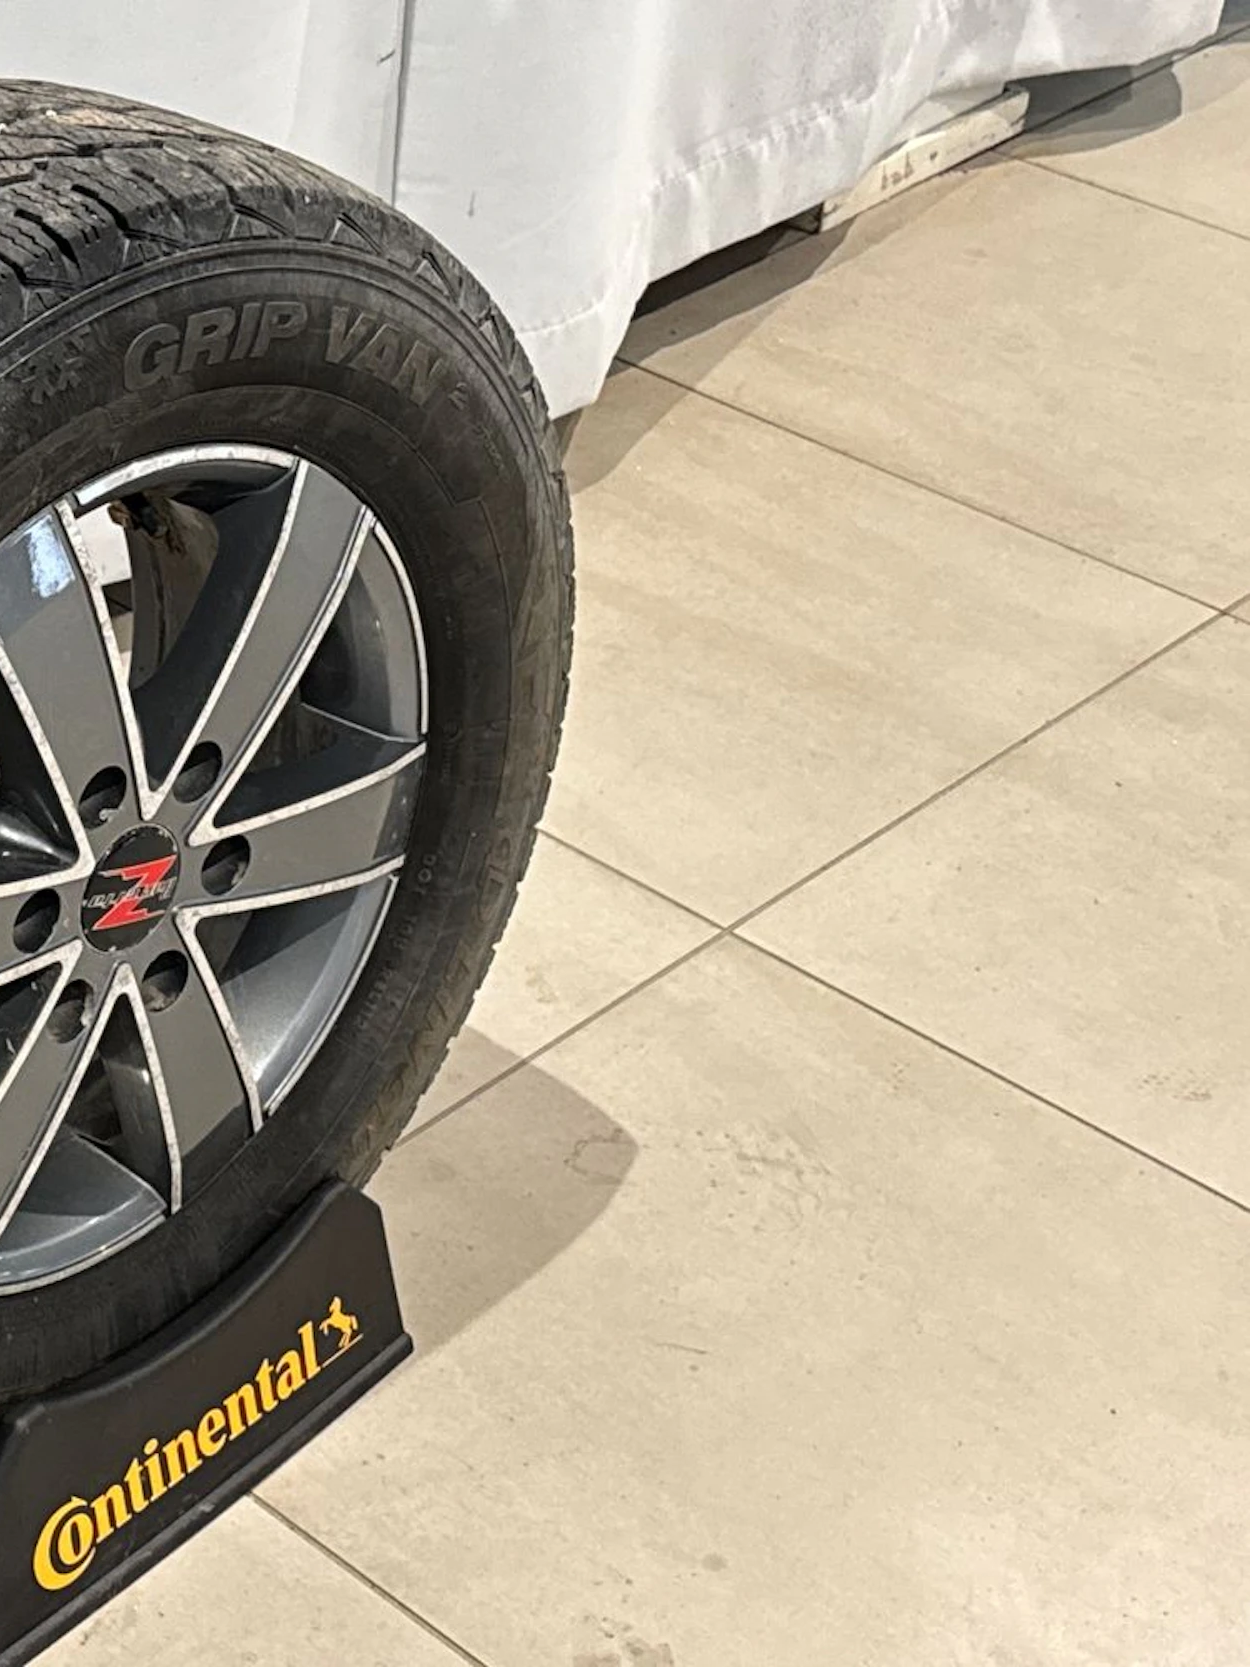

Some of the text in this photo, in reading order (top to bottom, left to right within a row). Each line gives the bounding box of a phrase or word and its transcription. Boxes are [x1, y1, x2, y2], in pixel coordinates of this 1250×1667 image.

[124, 301, 308, 393] GRIP
[325, 306, 448, 407] VAN
[32, 1320, 321, 1591] Continental
